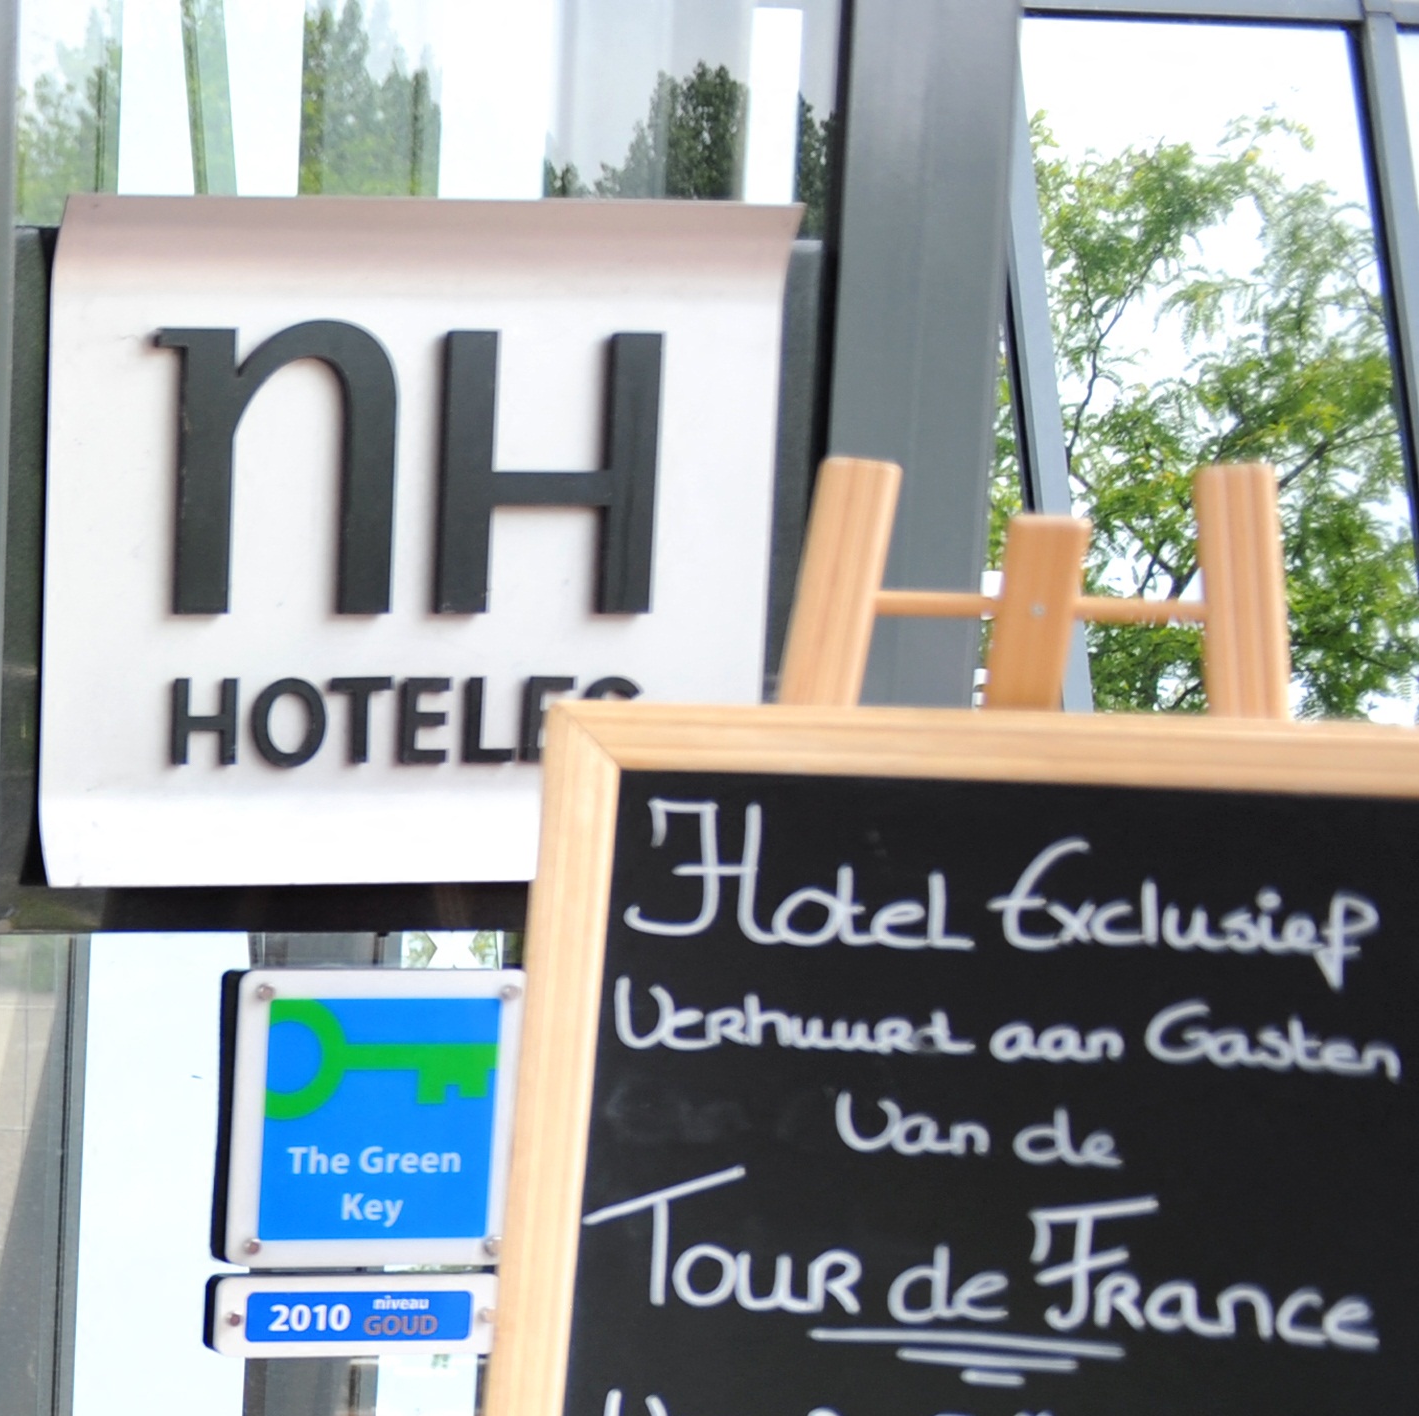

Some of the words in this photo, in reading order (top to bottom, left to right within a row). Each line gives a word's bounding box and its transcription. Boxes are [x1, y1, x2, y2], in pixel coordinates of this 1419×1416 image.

[170, 675, 644, 769] HOTELE
[623, 798, 975, 950] Hotel
[987, 837, 1380, 990] Exclusief
[989, 1021, 1124, 1061] aan
[1145, 999, 1401, 1080] Gasten
[287, 1145, 350, 1175] The
[358, 1146, 462, 1174] Green
[1013, 1107, 1124, 1168] de
[340, 1193, 404, 1227] Key
[582, 1166, 862, 1314] Tour
[886, 1245, 1010, 1322] de
[1029, 1196, 1380, 1349] France
[268, 1303, 351, 1333] 2010
[363, 1315, 438, 1336] GOUD
[373, 1296, 429, 1310] niveau
